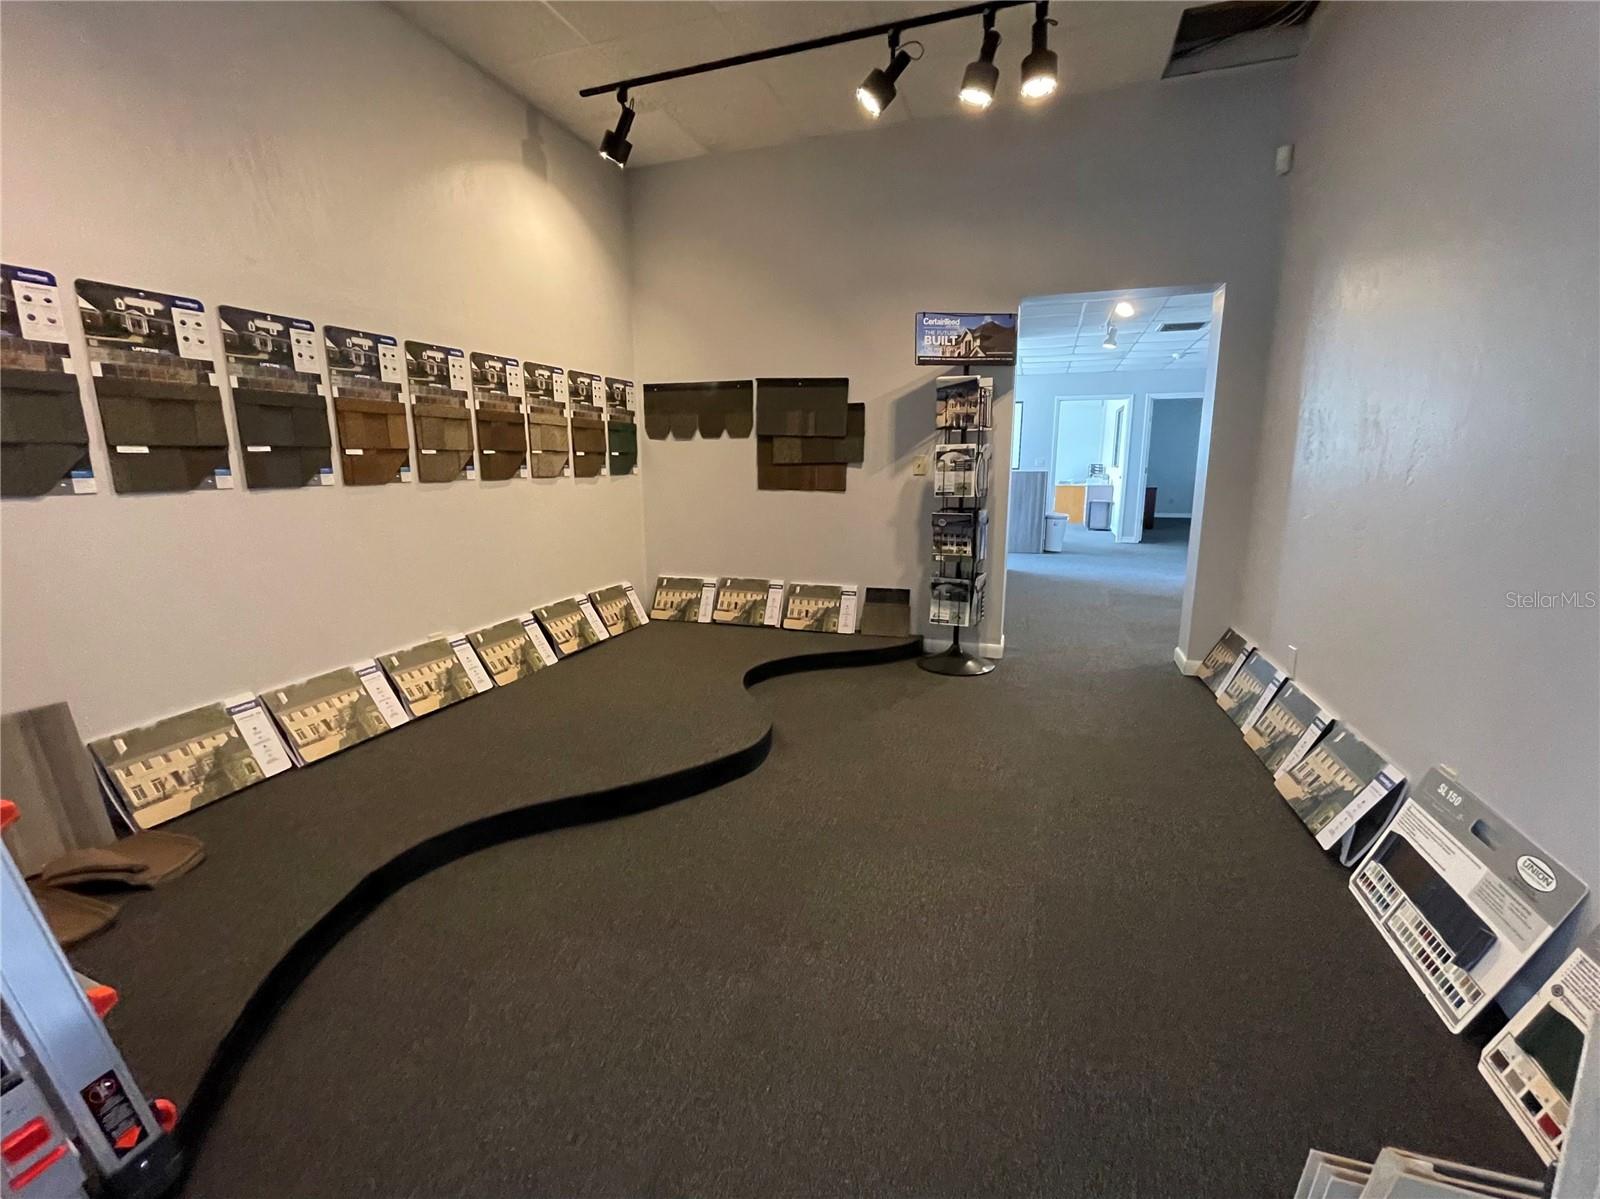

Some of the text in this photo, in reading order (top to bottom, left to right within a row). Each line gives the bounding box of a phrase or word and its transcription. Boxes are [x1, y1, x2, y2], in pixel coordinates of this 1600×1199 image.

[924, 335, 958, 345] BUILT
[1437, 783, 1462, 806] SL 150
[1522, 859, 1553, 887] UNION
